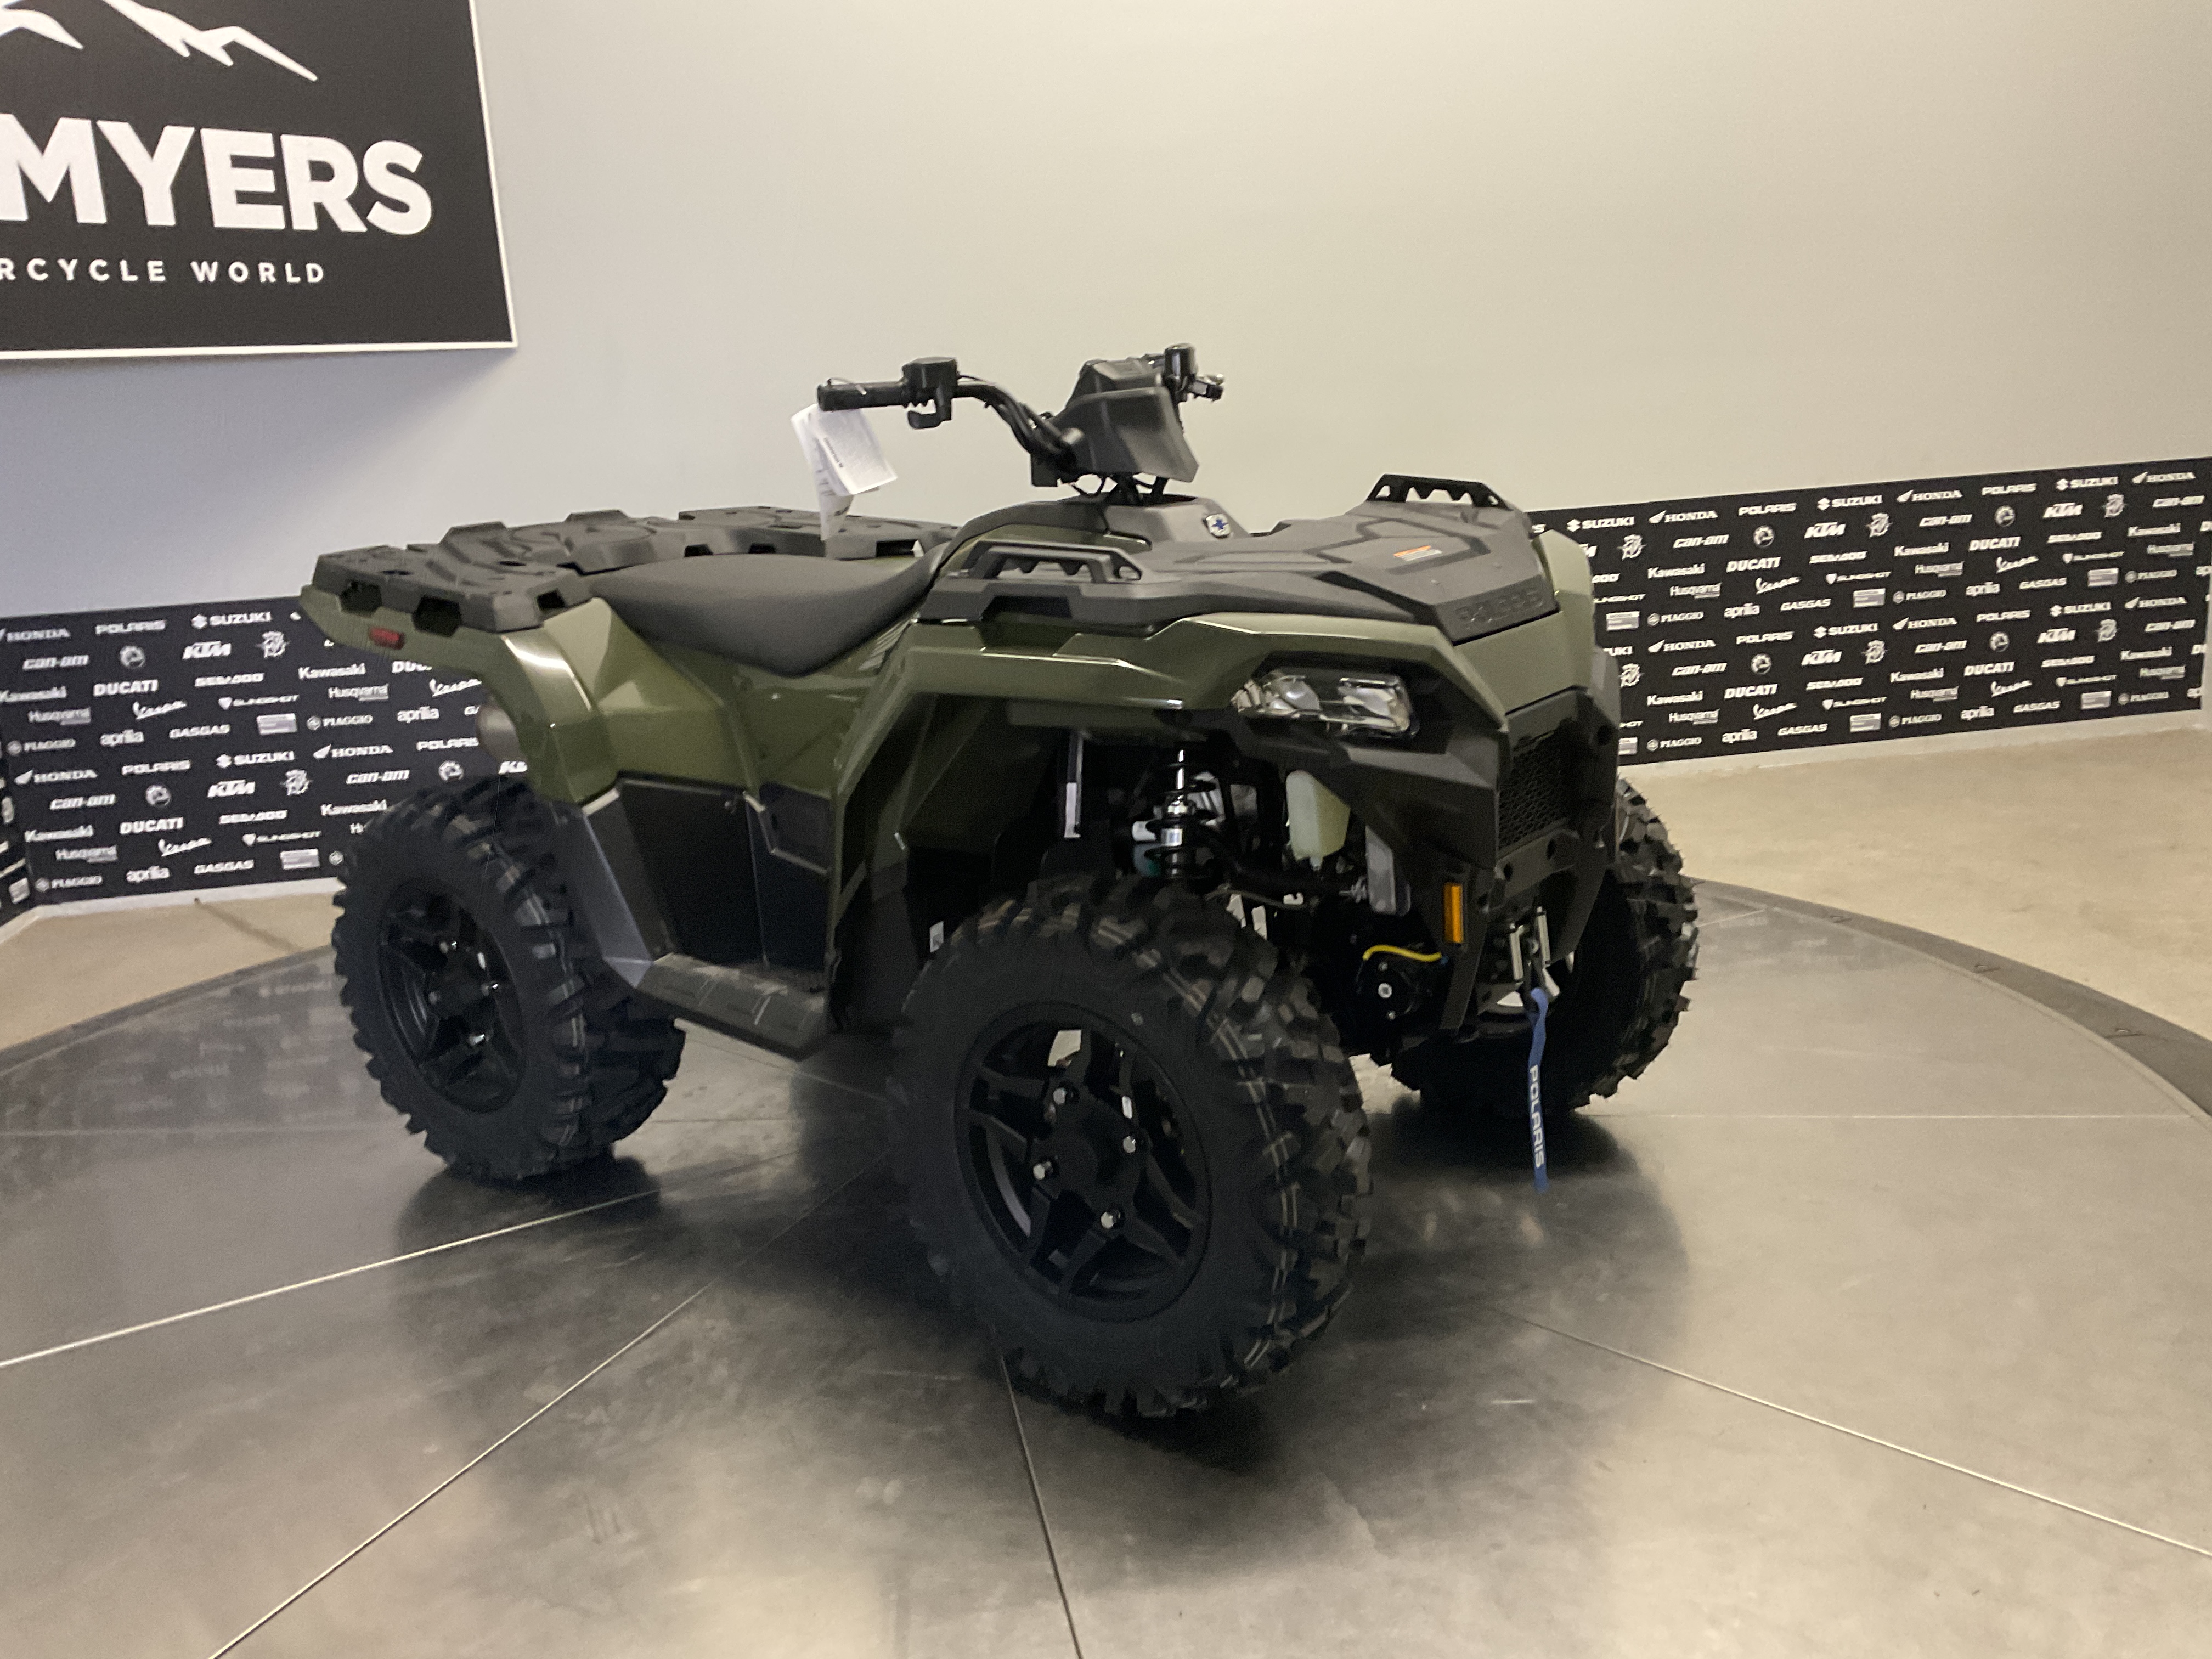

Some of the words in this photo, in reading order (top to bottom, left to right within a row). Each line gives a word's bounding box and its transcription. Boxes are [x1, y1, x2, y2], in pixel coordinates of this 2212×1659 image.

[0, 114, 432, 235] MYERS
[190, 261, 323, 283] WORLD
[2070, 477, 2118, 488] SUZUKI
[2147, 472, 2196, 482] HONDA
[1912, 490, 1962, 501] HONDA
[1982, 483, 2036, 495] POLARIS
[1832, 495, 1882, 507] SUZUKI
[1664, 510, 1718, 522] HONDA
[1739, 503, 1796, 515] POLARIS
[2043, 503, 2083, 518] KTM
[1582, 517, 1634, 529] SUZUKI
[1920, 514, 1972, 527] can-am
[1804, 522, 1846, 538] KTM
[2128, 523, 2180, 536] Kawasaki
[1673, 534, 1729, 548] can-am
[1969, 537, 2020, 551] DUCATI
[1894, 542, 1949, 556] Kawasaki
[1648, 563, 1705, 578] Kawasaki
[1726, 557, 1781, 572] DUCATI
[2019, 578, 2067, 589] GASGAS
[1724, 603, 1759, 618] aprilia
[1781, 599, 1831, 611] GASGAS
[2064, 602, 2111, 614] SUZUKI
[210, 612, 272, 625] SUZUKI
[1661, 612, 1703, 622] PIAGGIO
[1977, 610, 2030, 622] POLARIS
[95, 620, 165, 634] POLARIS
[1828, 623, 1878, 635] SUZUKI
[1909, 618, 1957, 629] HONDA
[7, 629, 70, 642] HONDA
[1736, 631, 1793, 644] POLARIS
[2038, 628, 2075, 643] KTM
[183, 641, 231, 659] KTM
[1663, 640, 1716, 651] HONDA
[1915, 640, 1967, 653] can-am
[22, 655, 89, 670] can-am
[1801, 650, 1842, 665] KTM
[298, 663, 366, 679] Kawasaki
[1672, 663, 1727, 676] can-am
[1891, 668, 1944, 682] Kawasaki
[1964, 662, 2015, 676] DUCATI
[94, 680, 158, 696] DUCATI
[1724, 684, 1778, 698] DUCATI
[1647, 691, 1703, 706] Kawasaki
[2013, 701, 2061, 713] GASGAS
[323, 715, 373, 726] PIAGGIO
[397, 706, 439, 723] aprilia
[170, 725, 230, 738] GASGAS
[1722, 729, 1757, 743] aprilia
[1778, 724, 1827, 736] GASGAS
[100, 729, 144, 746] aprilia
[1660, 737, 1702, 748] PIAGGIO
[234, 751, 295, 765] SUZUKI
[331, 745, 393, 757] HONDA
[122, 760, 190, 775] POLARIS
[34, 770, 97, 783] HONDA
[346, 770, 410, 784] can-am
[207, 780, 255, 798] KTM
[50, 794, 115, 810] can-am
[321, 800, 387, 816] Kawasaki
[120, 817, 183, 834] DUCATI
[25, 825, 93, 842] Kawasaki
[194, 860, 254, 874] GASGAS
[127, 866, 170, 883] aprilia
[1530, 1064, 1545, 1168] POLARIS
